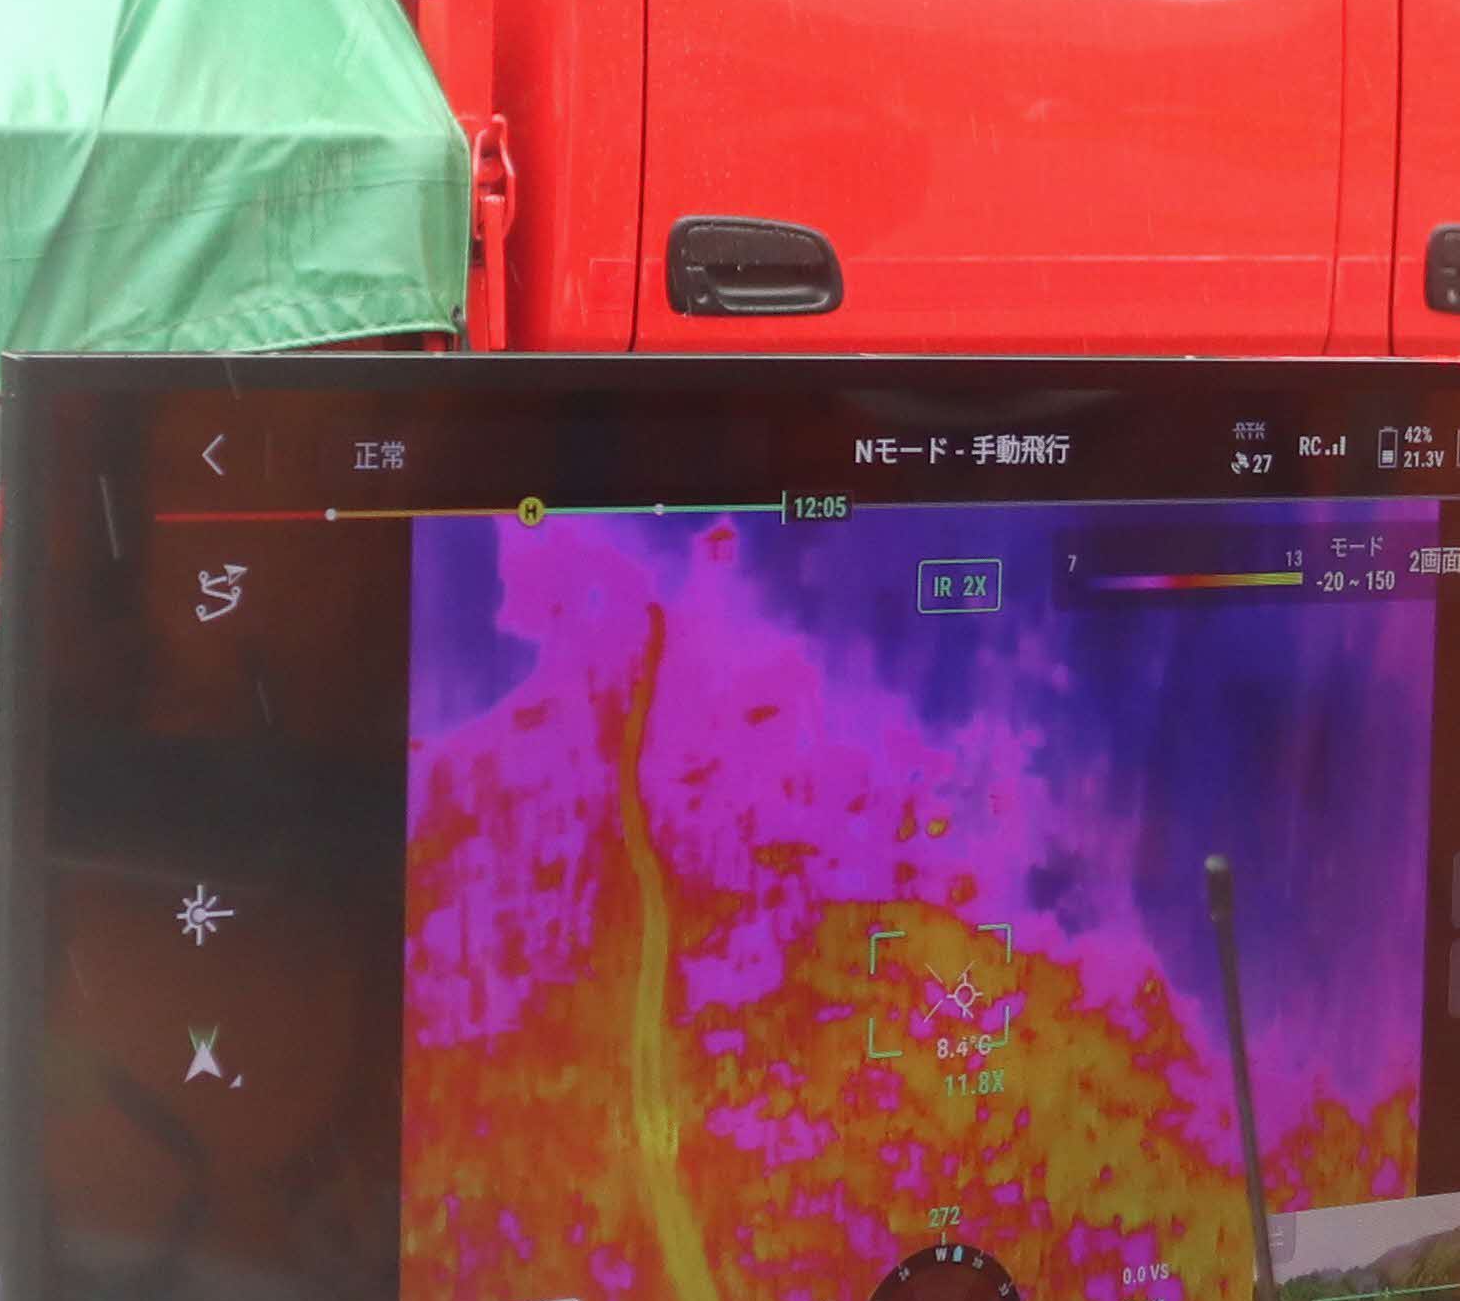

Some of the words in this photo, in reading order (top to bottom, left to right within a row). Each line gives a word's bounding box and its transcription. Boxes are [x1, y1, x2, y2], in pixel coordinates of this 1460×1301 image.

[1298, 435, 1324, 457] RC
[1404, 426, 1434, 444] 42%
[353, 441, 406, 471] 正常
[854, 437, 948, 465] Nモード
[971, 433, 1071, 466] 手動飛行
[1403, 450, 1445, 469] 21.3V
[1252, 454, 1273, 475] 27
[794, 495, 848, 520] 12:05
[1331, 535, 1385, 558] モード
[1067, 554, 1078, 573] 7
[1285, 550, 1304, 568] 13
[934, 576, 952, 598] IR
[963, 575, 988, 598] 2X
[1366, 569, 1396, 592] 150
[928, 1205, 961, 1228] 272
[934, 1247, 947, 1263] W
[1122, 1265, 1146, 1286] 0.0
[1150, 1262, 1170, 1281] VS
